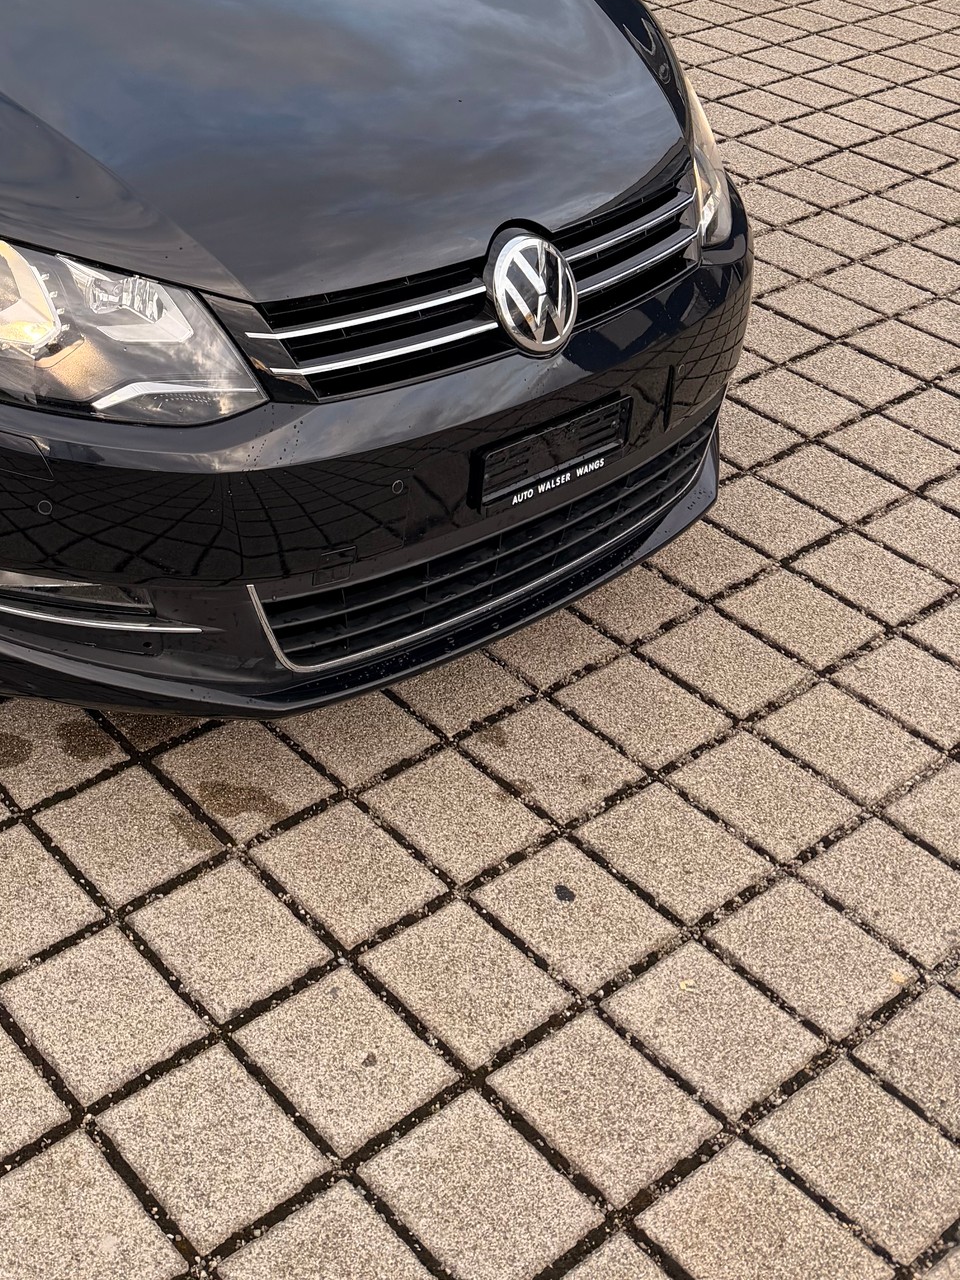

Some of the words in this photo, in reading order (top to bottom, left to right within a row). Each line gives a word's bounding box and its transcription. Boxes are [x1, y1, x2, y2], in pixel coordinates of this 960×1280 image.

[512, 489, 534, 505] AUTO
[538, 472, 571, 494] WALSER
[576, 458, 605, 477] WANGS
